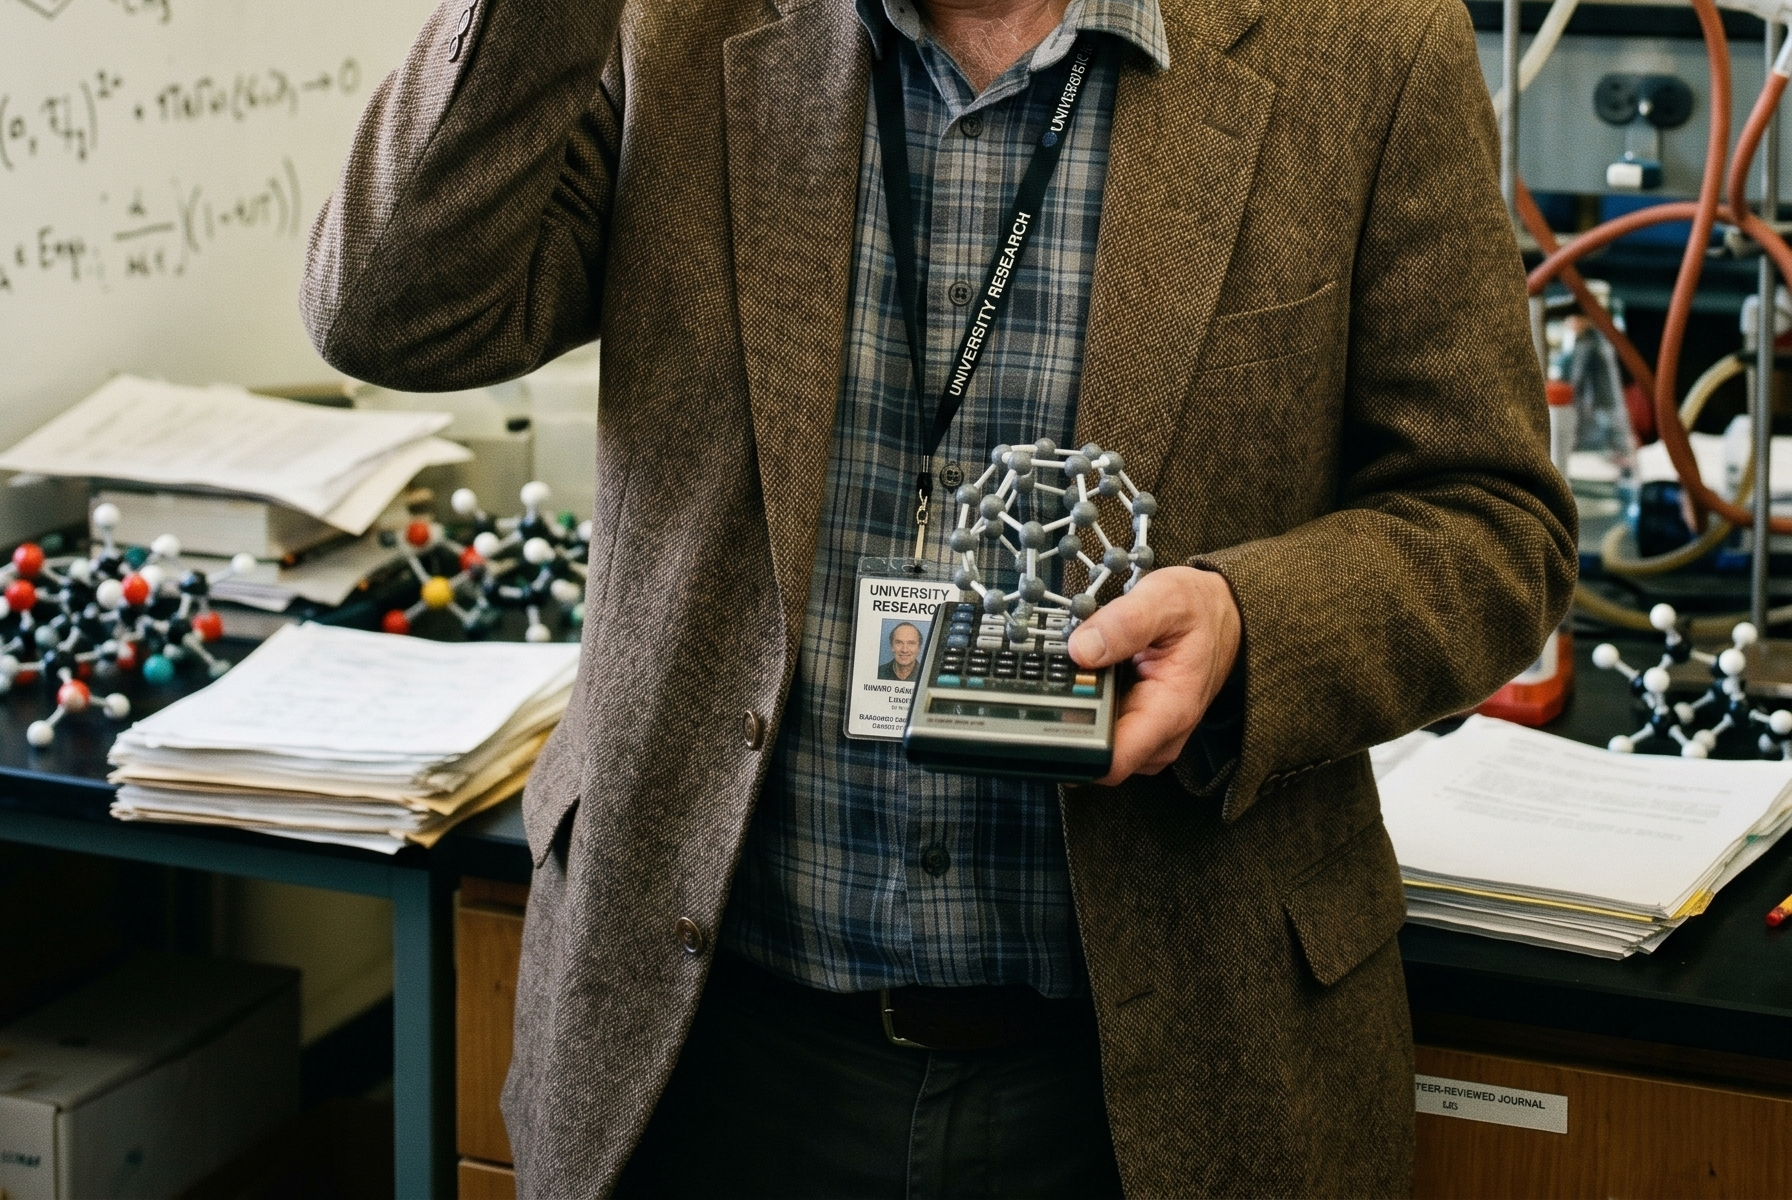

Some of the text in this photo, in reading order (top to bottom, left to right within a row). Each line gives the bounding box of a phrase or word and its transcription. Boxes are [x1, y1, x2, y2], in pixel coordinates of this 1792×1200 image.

[949, 211, 1032, 397] UNIVERSITY RESEARCH
[870, 584, 950, 601] UNIVERSITY
[872, 599, 938, 616] RESEARC
[1497, 1094, 1546, 1110] JOURNAL
